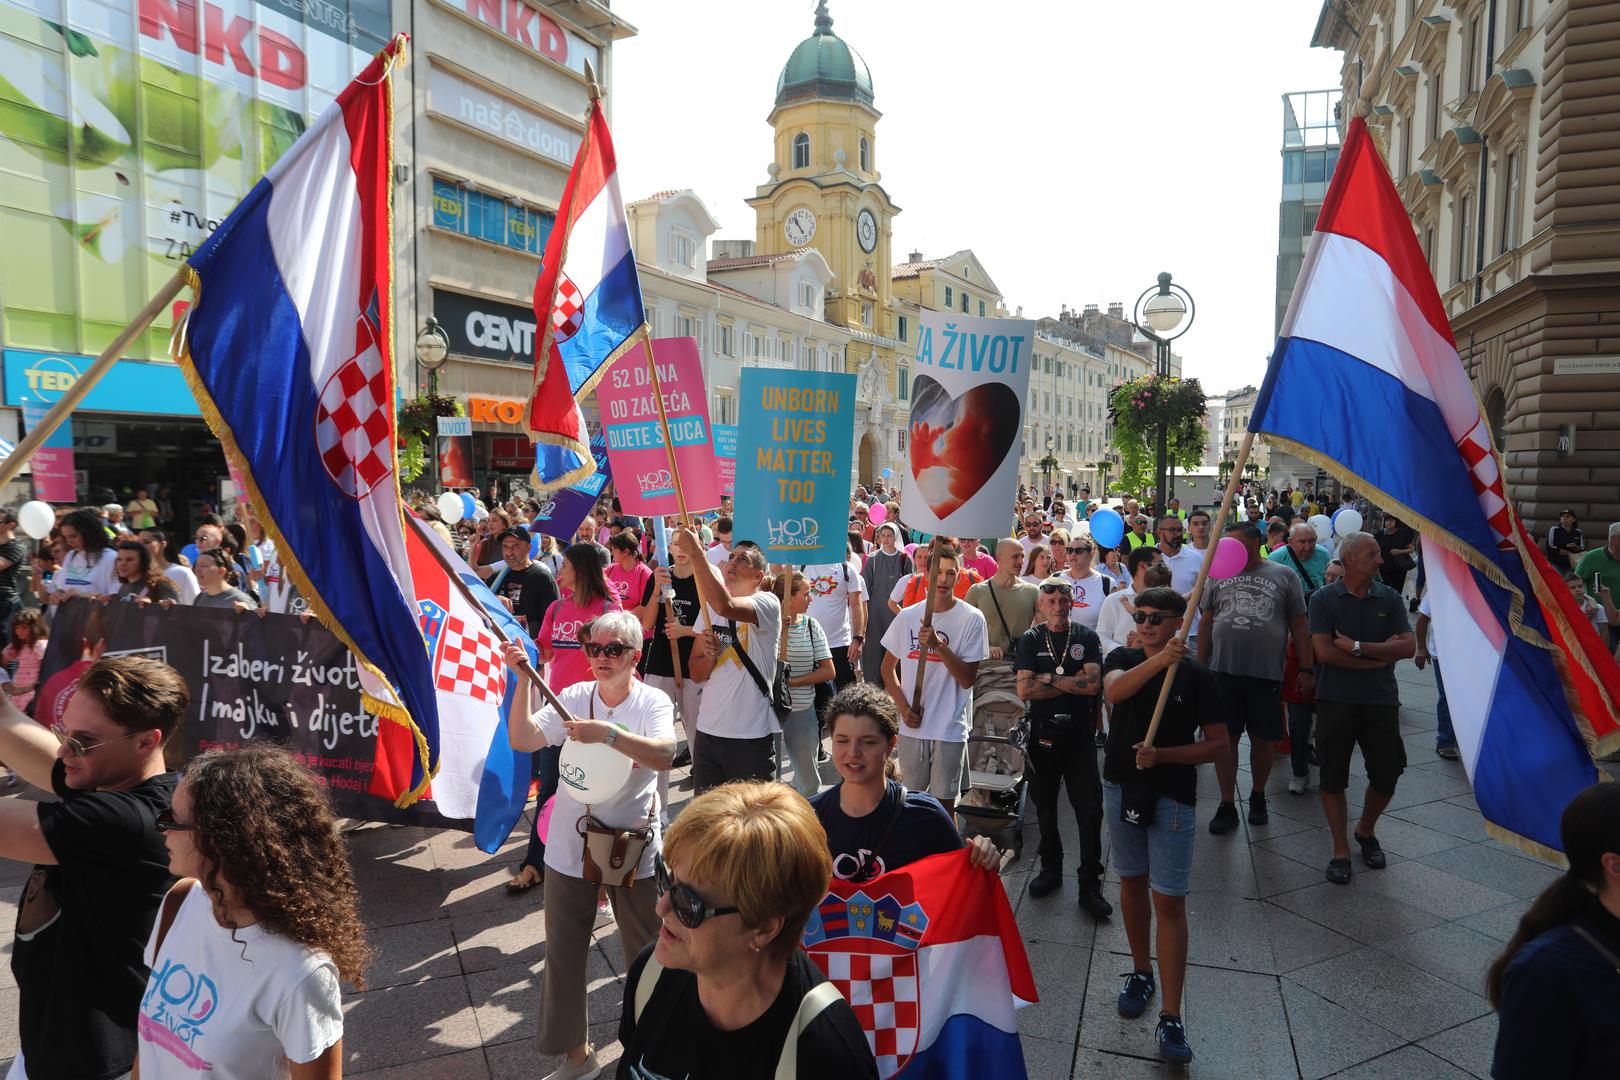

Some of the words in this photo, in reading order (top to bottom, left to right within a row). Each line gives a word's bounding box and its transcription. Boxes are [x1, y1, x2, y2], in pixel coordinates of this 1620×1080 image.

[278, 0, 359, 39] ENTRA
[465, 0, 568, 65] NKD
[139, 0, 308, 91] NKD
[460, 96, 502, 132] naš
[527, 125, 570, 166] dom
[465, 311, 536, 355] CENT
[939, 323, 1025, 374] ŽIVOT
[24, 368, 81, 392] TED
[612, 369, 631, 388] 52
[468, 397, 525, 424] KO
[610, 399, 628, 419] OD
[631, 389, 691, 417] ZAČEĆA
[762, 385, 839, 414] UNBORN
[609, 427, 652, 448] DIJETE
[655, 421, 704, 444] ŠUCA
[772, 416, 827, 444] LIVES
[636, 469, 672, 486] HOD
[757, 447, 837, 479] MATTER,
[777, 479, 816, 504] TOO
[767, 517, 819, 539] HOD
[768, 536, 785, 546] ZA
[787, 535, 821, 546] ŽIVOT
[614, 581, 630, 592] OD
[1219, 576, 1252, 590] MOTOR
[1254, 576, 1278, 591] CLUB
[203, 639, 285, 684] Izaberi
[212, 688, 279, 740] majku
[286, 702, 299, 728] i
[309, 692, 380, 750] dijete
[832, 848, 886, 880] OD
[151, 1000, 205, 1051] ŽIVOT
